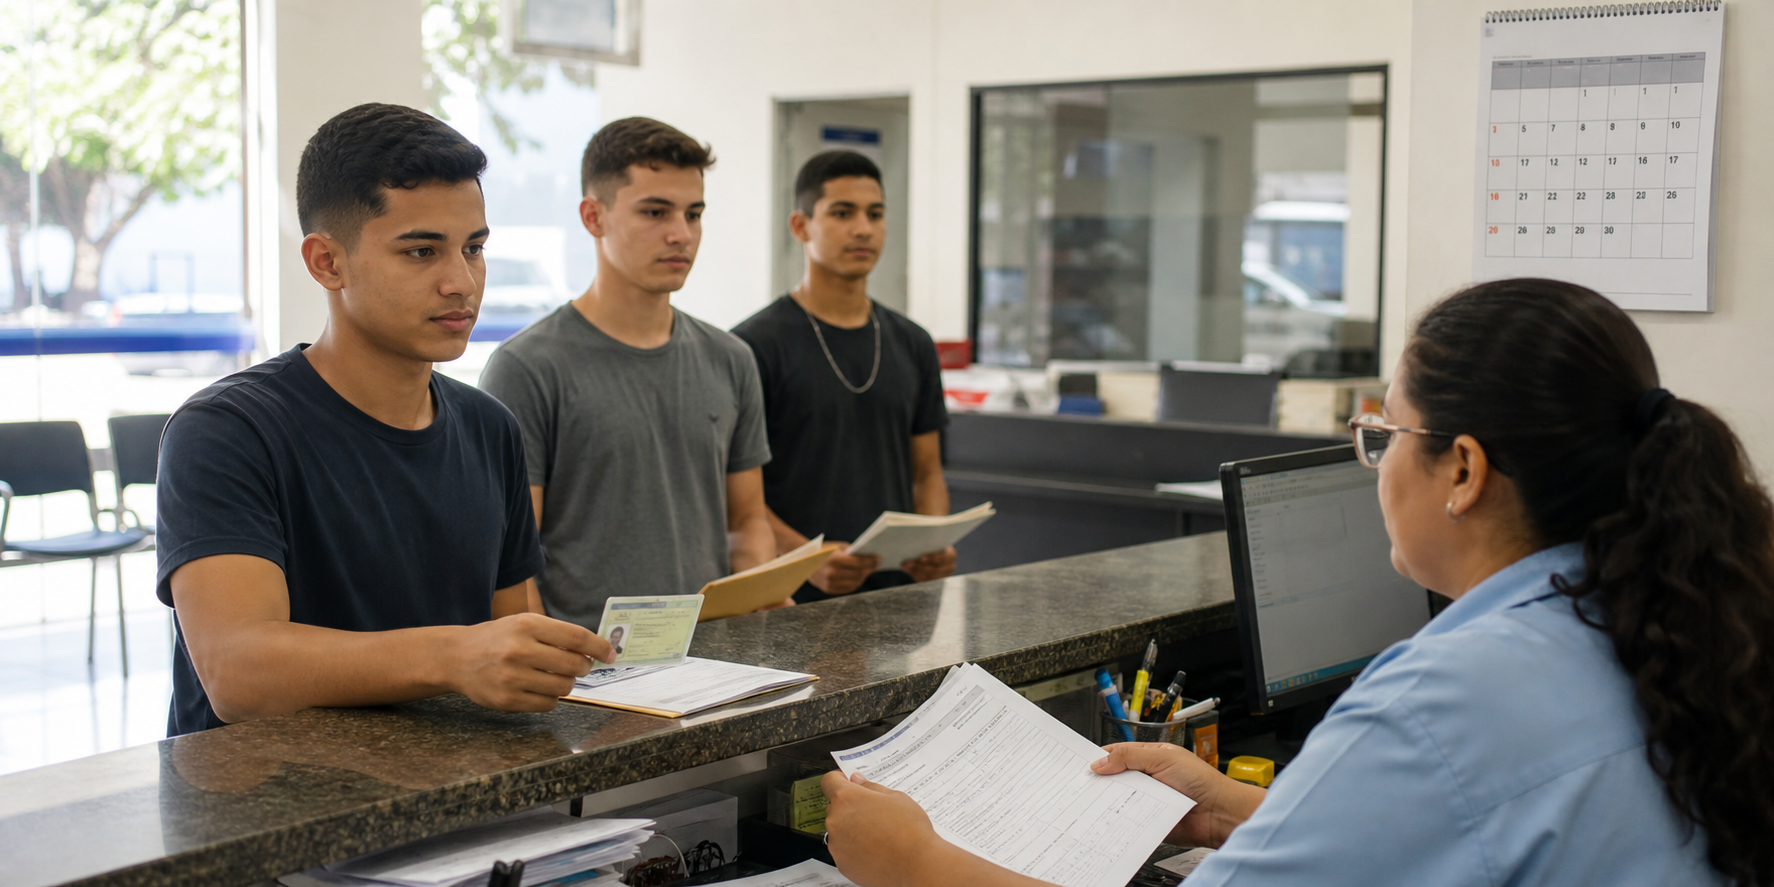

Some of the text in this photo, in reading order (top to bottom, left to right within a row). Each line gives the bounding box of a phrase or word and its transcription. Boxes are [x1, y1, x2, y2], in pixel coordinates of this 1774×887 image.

[1671, 120, 1681, 129] 10
[1578, 157, 1588, 166] 12
[1638, 156, 1648, 165] 16
[1669, 155, 1679, 164] 17
[1603, 226, 1615, 235] 30
